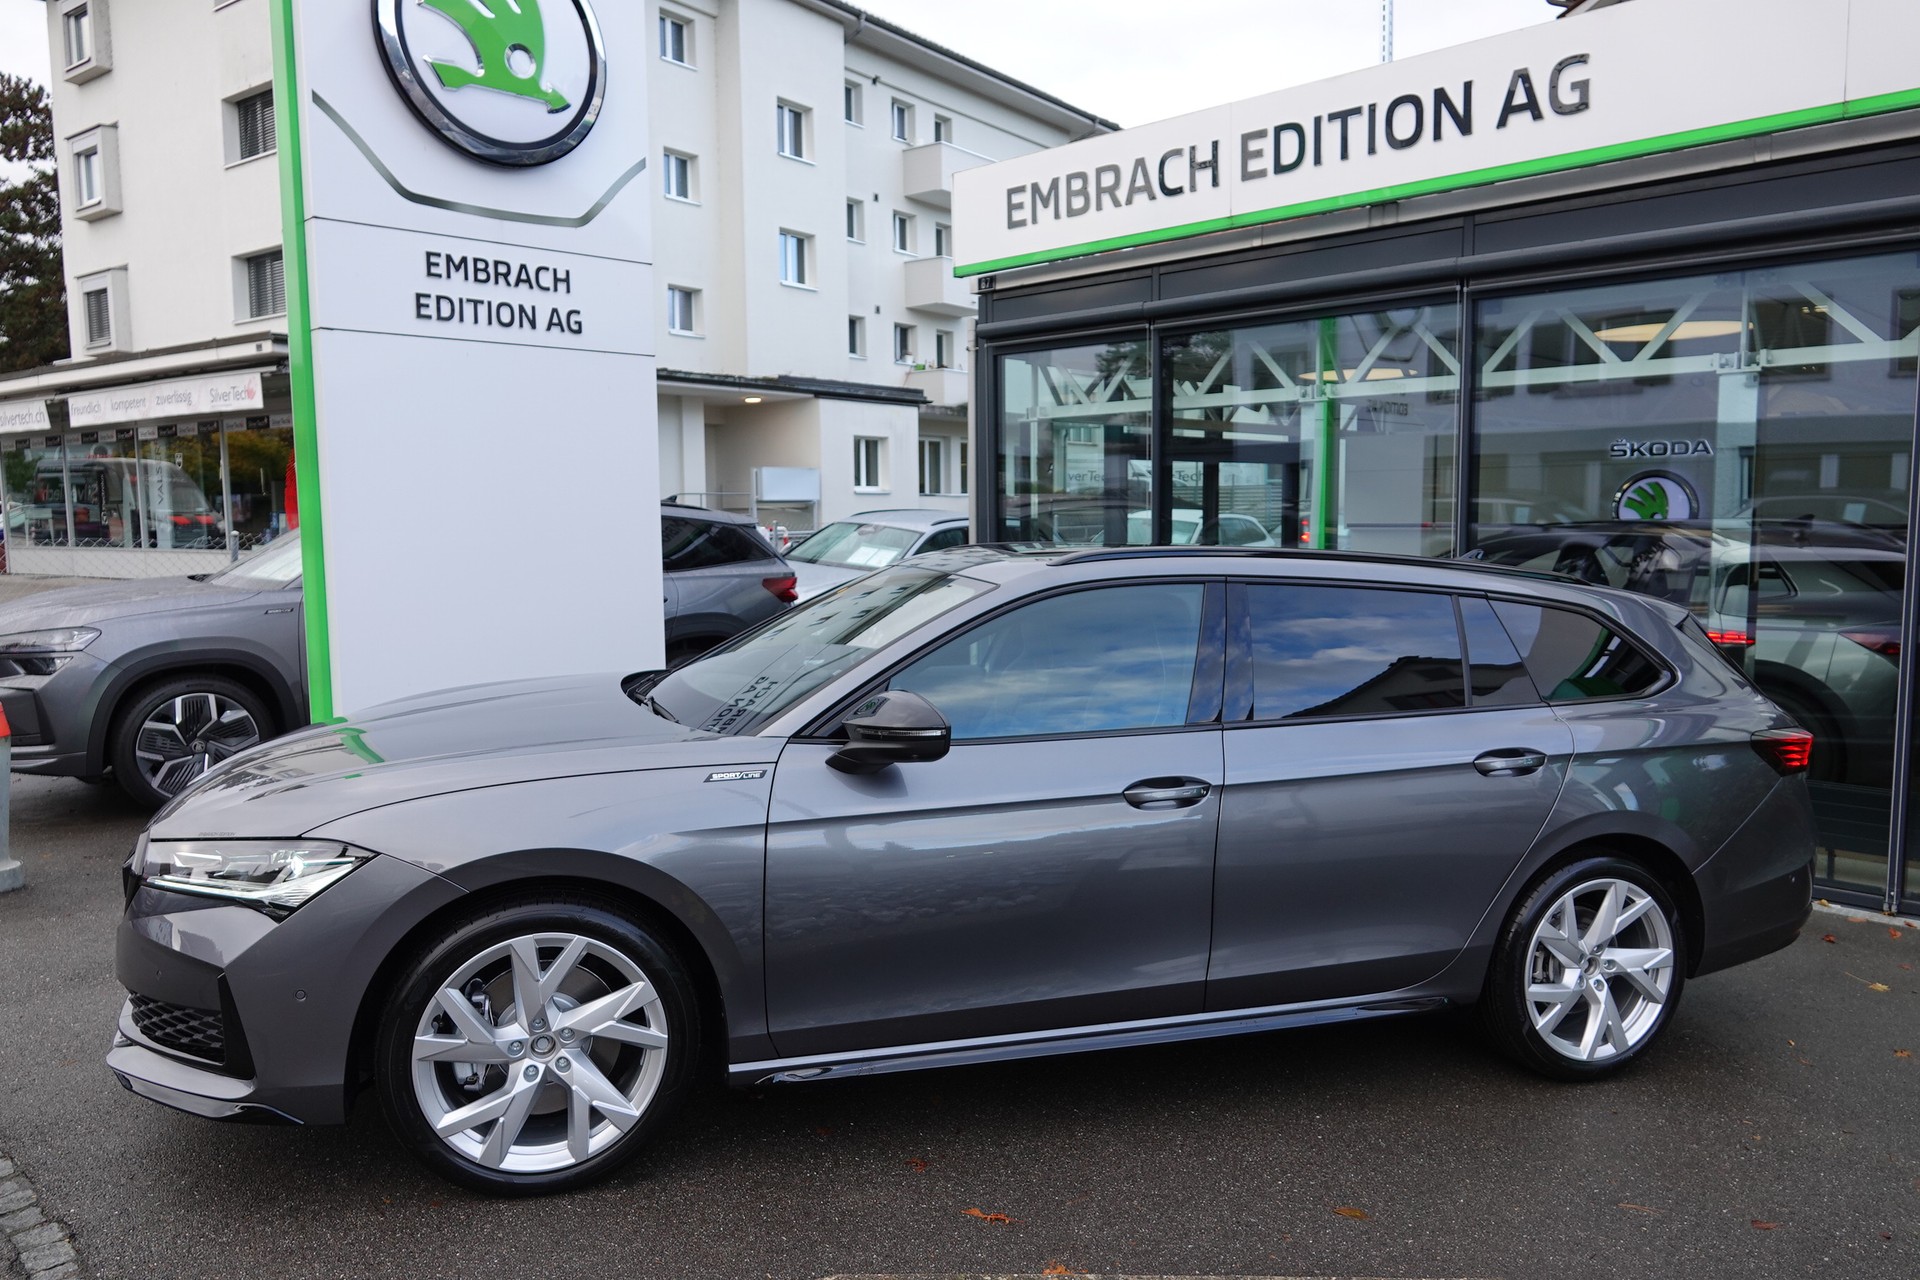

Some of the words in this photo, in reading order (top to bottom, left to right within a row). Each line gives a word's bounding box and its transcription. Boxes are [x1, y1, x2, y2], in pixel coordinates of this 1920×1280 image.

[1006, 138, 1220, 230] EMBRACH
[1240, 80, 1475, 183] EDITION
[1496, 52, 1592, 129] AG
[425, 251, 571, 294] EMBRACH
[415, 292, 537, 330] EDITION
[545, 306, 583, 335] AG
[70, 400, 102, 417] freundlich
[110, 396, 147, 415] kompetent
[209, 385, 250, 404] SilverTech
[1609, 438, 1714, 458] ŠKODA
